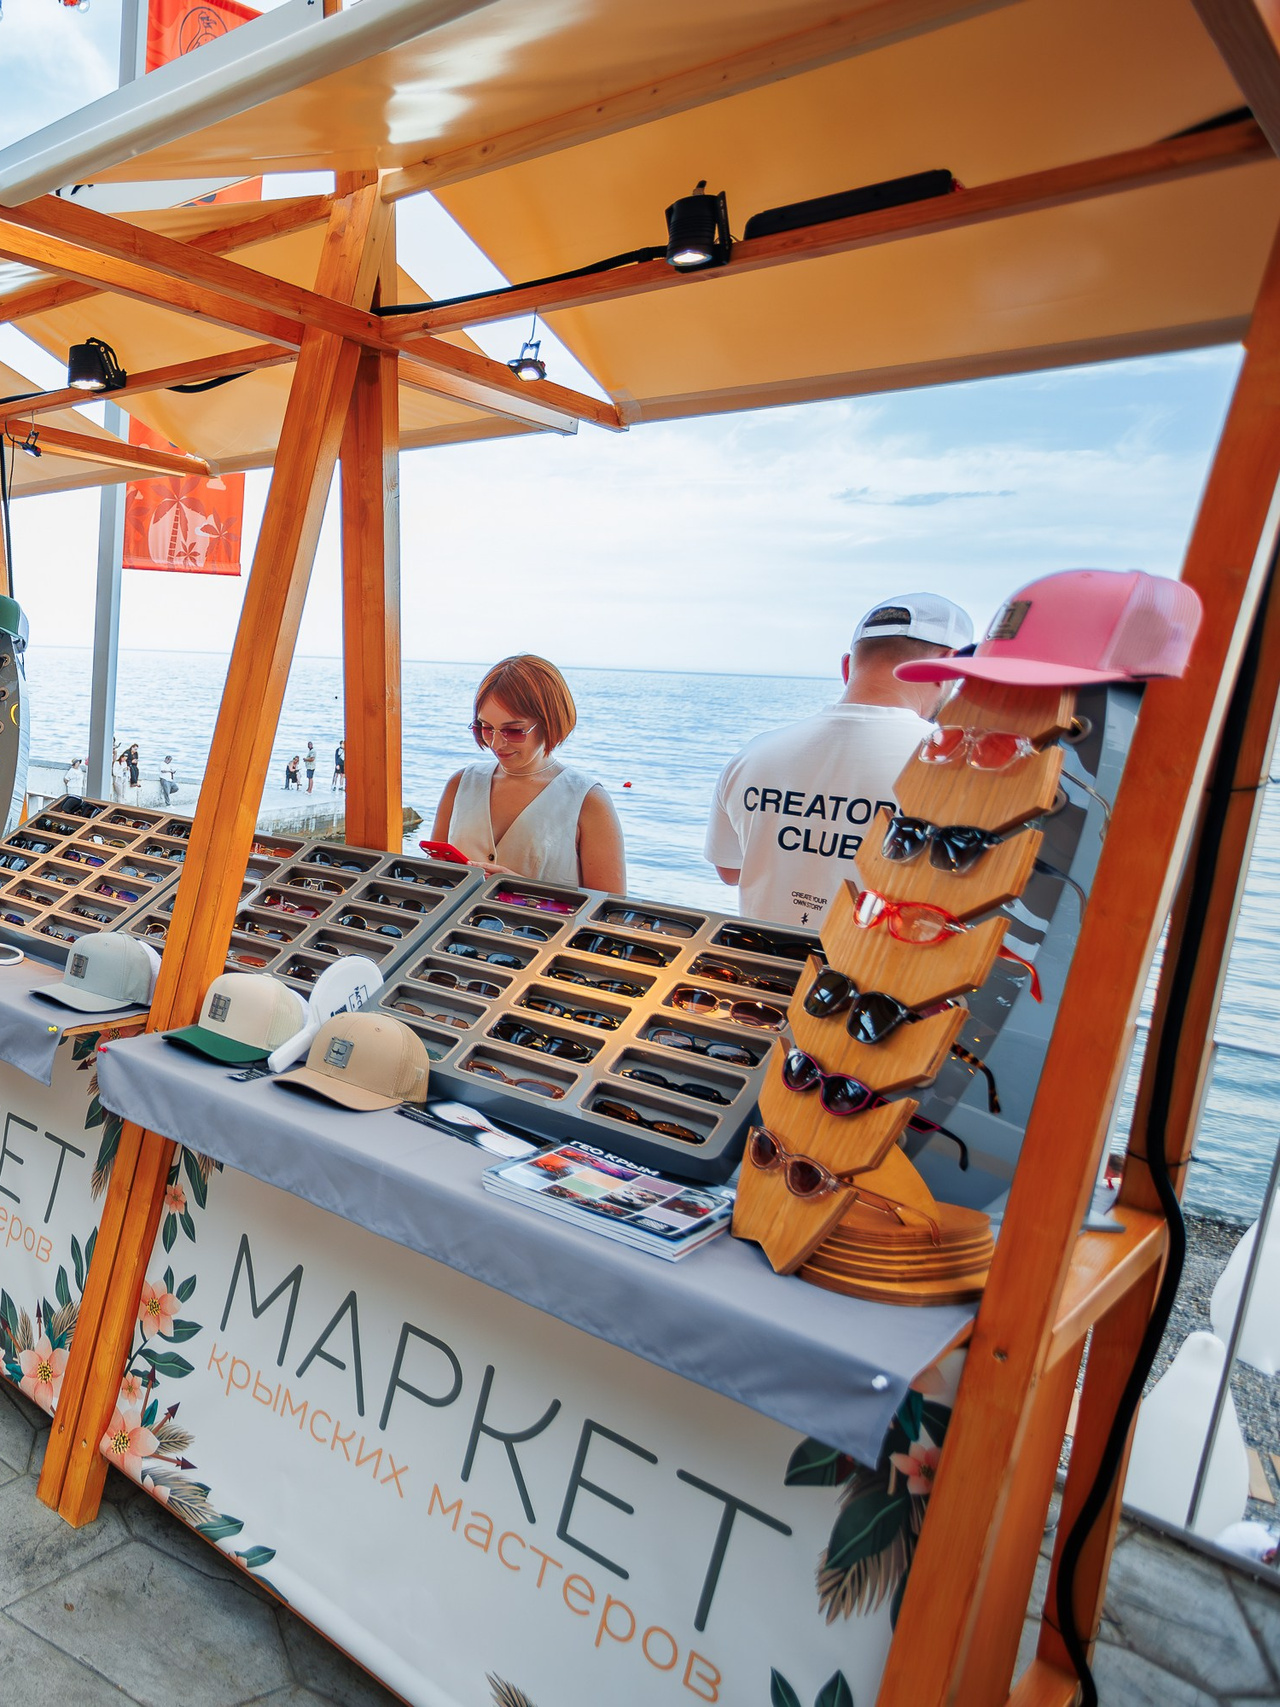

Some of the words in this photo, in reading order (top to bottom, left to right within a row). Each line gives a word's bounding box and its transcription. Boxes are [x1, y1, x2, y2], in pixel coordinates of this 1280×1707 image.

[777, 826, 863, 860] CLUB
[791, 891, 812, 901] CREATE
[812, 897, 828, 905] YOUR
[793, 898, 806, 907] OWN
[806, 902, 824, 911] STORY
[569, 1140, 604, 1155] ГЕО
[604, 1153, 660, 1176] КРЫМ
[220, 1233, 793, 1632] МАРКЕТ
[207, 1343, 410, 1499] крымских
[428, 1483, 722, 1703] мастеров
